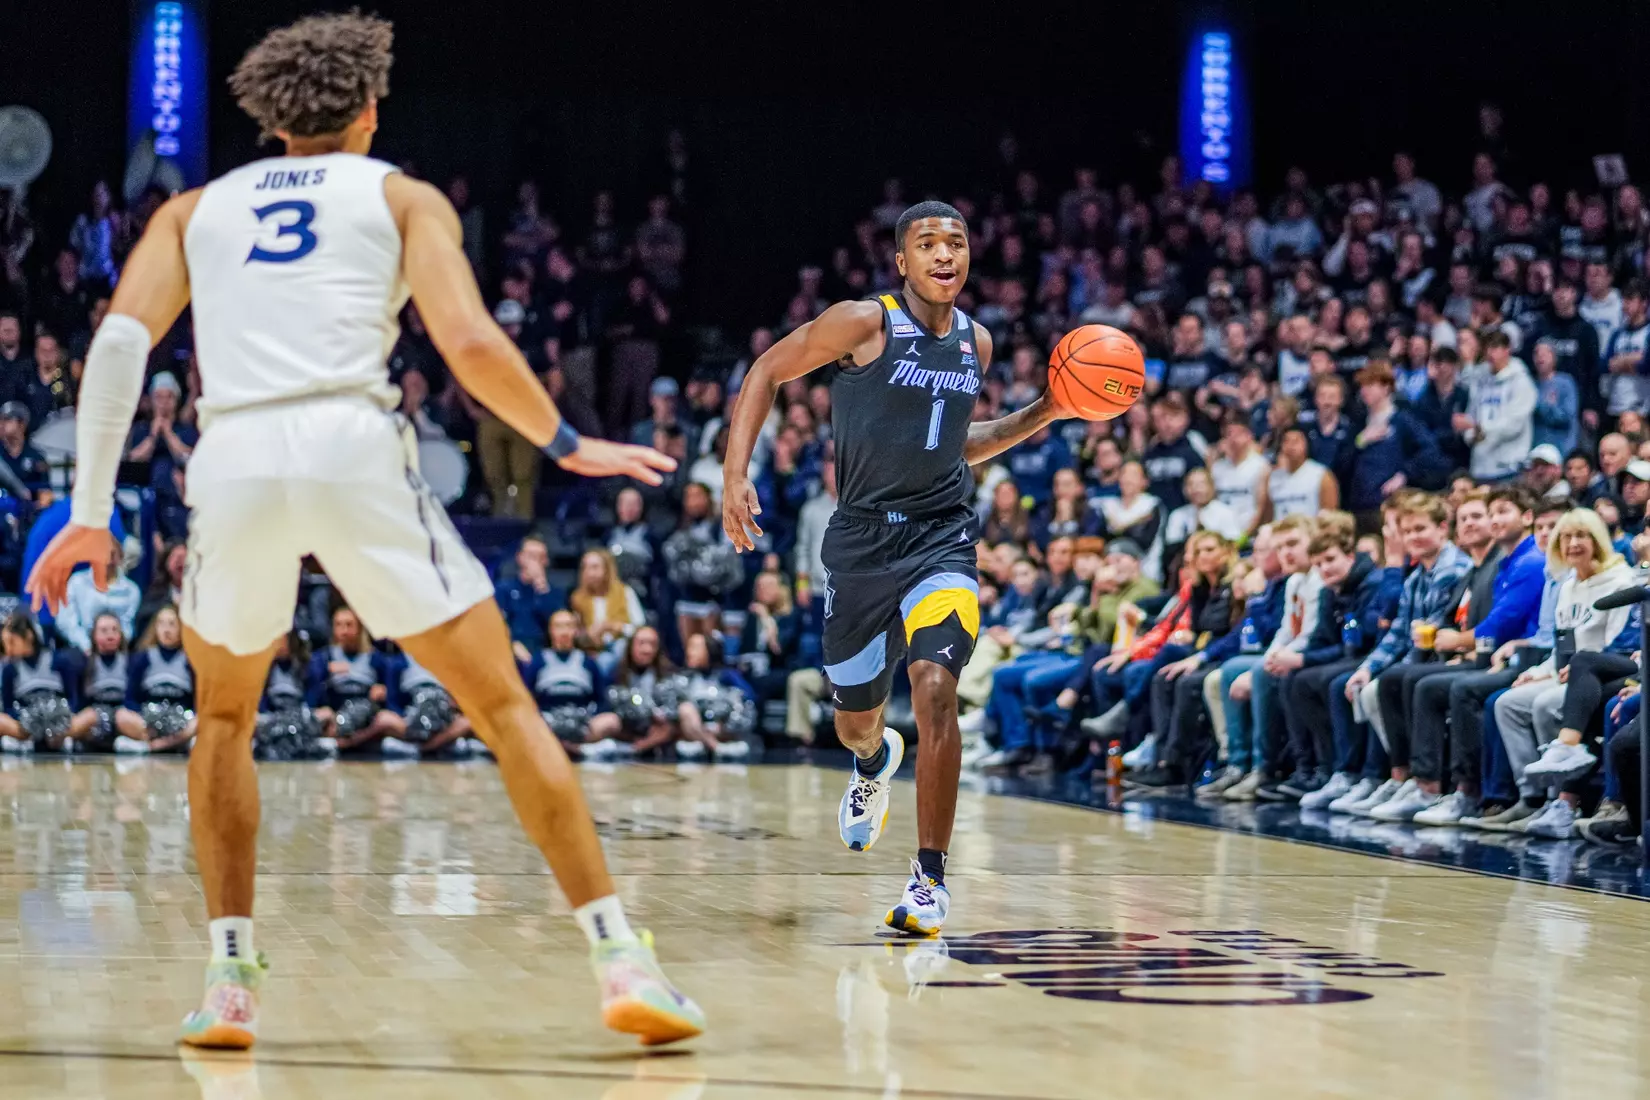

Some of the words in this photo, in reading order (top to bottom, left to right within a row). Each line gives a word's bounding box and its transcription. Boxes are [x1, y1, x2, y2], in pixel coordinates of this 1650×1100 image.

[254, 168, 327, 190] JONES
[243, 199, 318, 267] 3
[887, 359, 980, 396] Marquette
[1103, 377, 1142, 399] ELITE
[924, 399, 945, 451] 1
